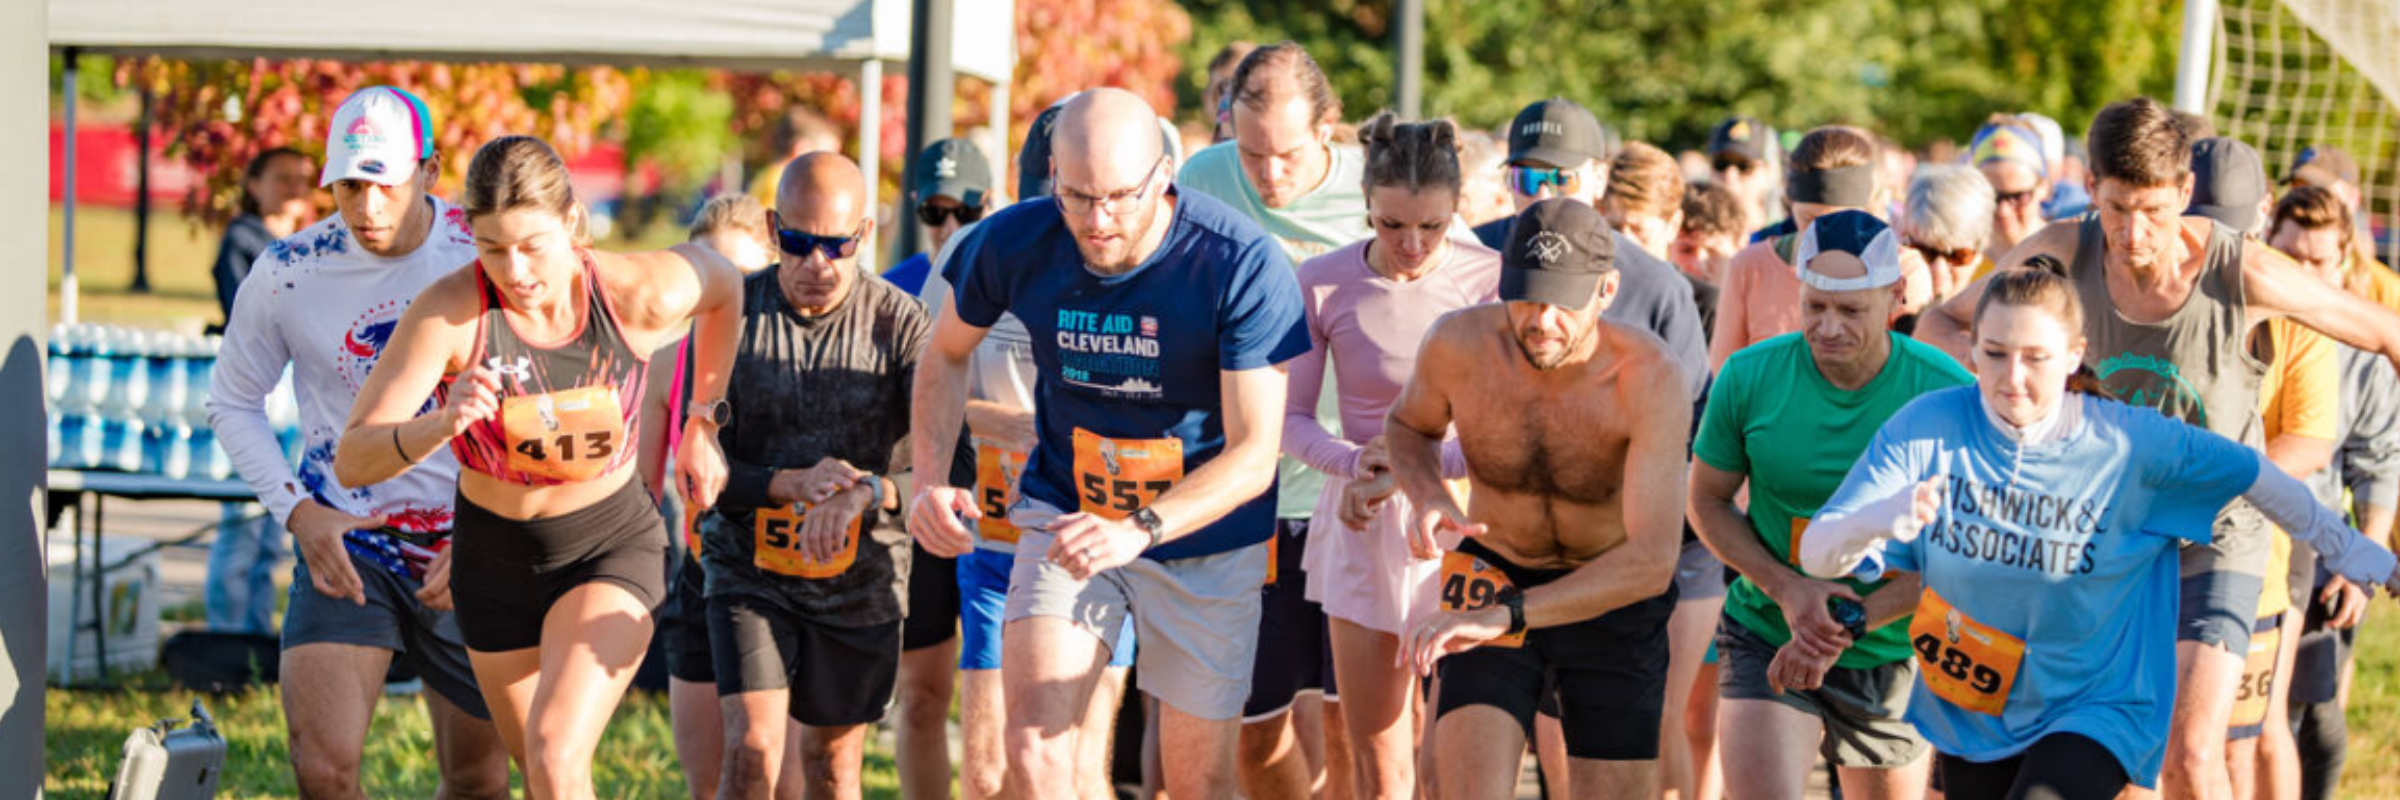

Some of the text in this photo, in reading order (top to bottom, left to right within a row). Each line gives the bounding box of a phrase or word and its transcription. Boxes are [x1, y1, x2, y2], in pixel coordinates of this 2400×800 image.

[1057, 309, 1134, 334] RITE AID
[1057, 330, 1160, 358] CLEVELAND
[515, 431, 613, 461] 413
[1083, 472, 1173, 511] 557
[1930, 516, 2097, 575] ASSOCIATES
[1443, 572, 1497, 611] 49
[1913, 632, 2002, 695] 489
[2235, 669, 2272, 701] 36
